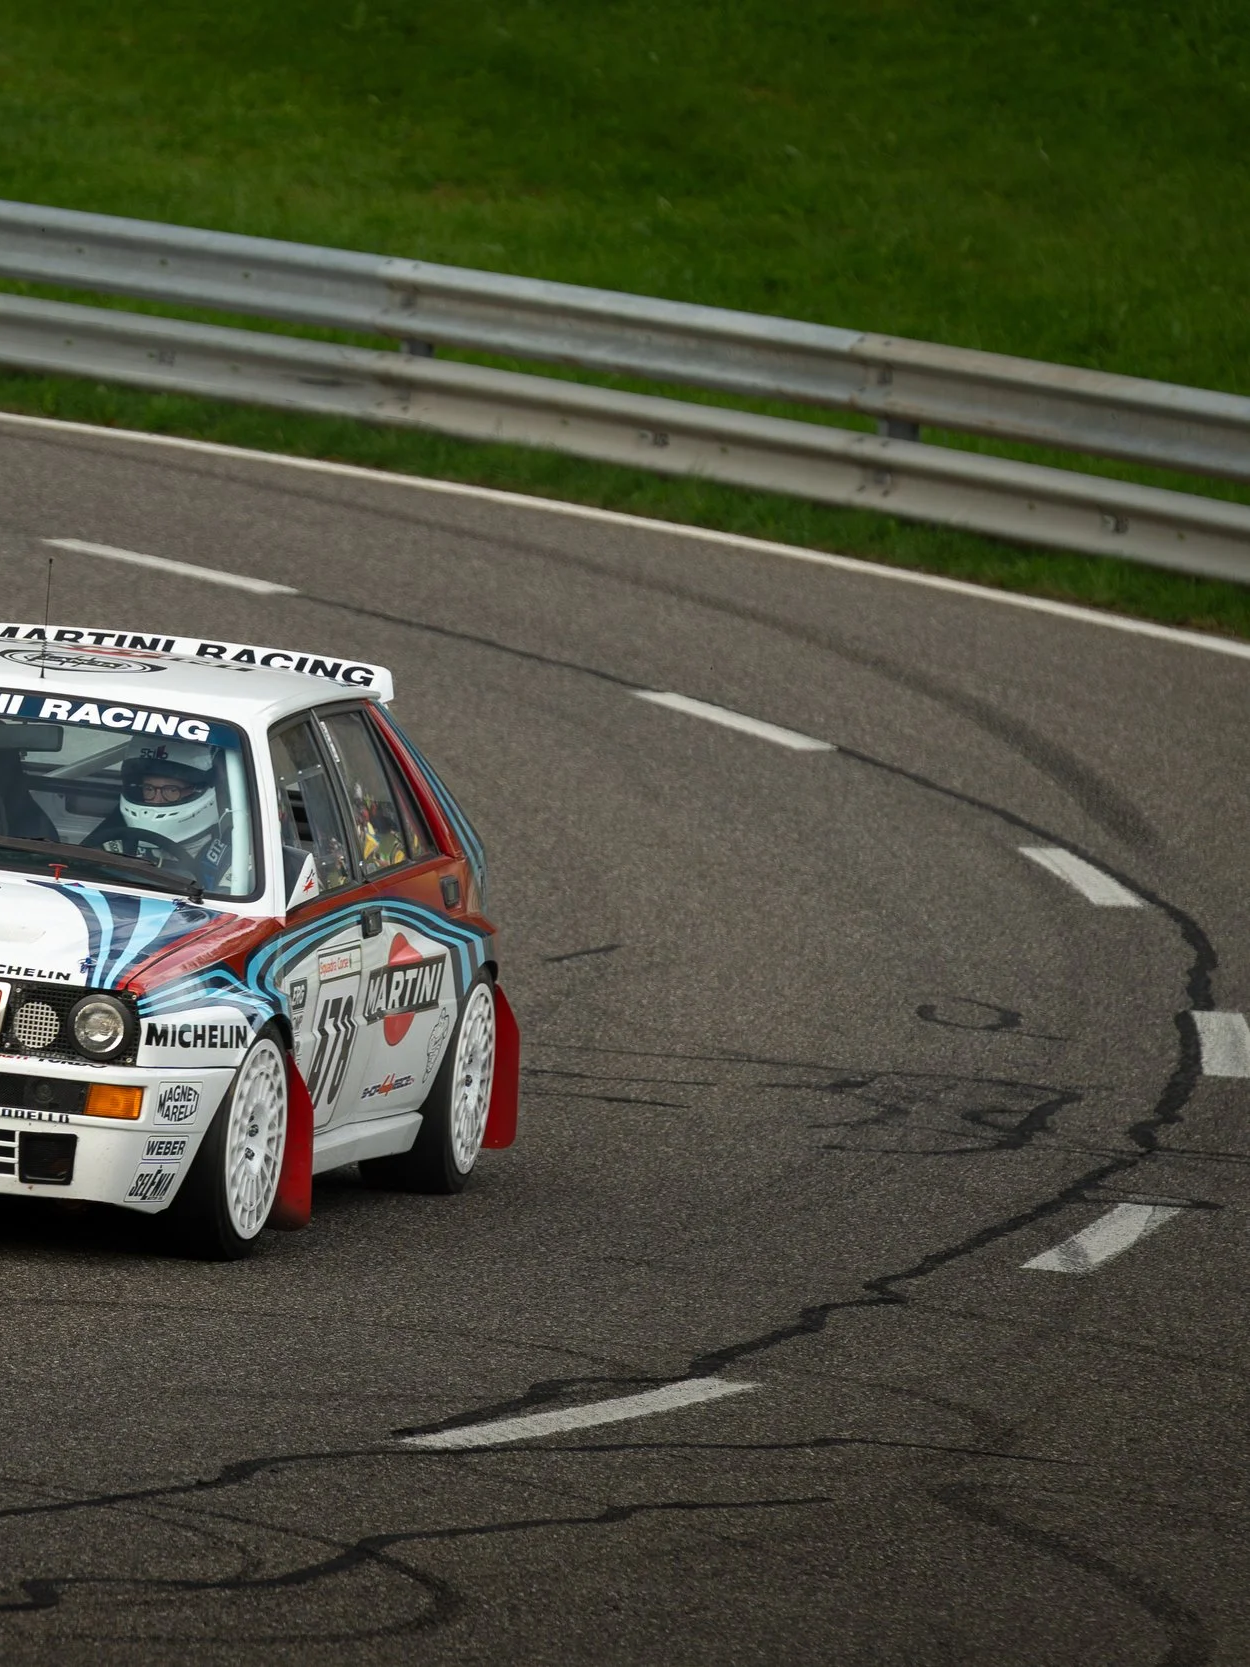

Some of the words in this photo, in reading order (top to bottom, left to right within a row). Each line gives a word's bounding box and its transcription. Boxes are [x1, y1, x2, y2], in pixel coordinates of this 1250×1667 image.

[196, 643, 375, 687] RACING
[39, 698, 211, 742] RACING
[365, 963, 443, 1017] MARTINI
[144, 1022, 248, 1049] MICHELIN
[159, 1085, 200, 1103] MAGNETI
[157, 1103, 198, 1122] MARELLI
[146, 1140, 186, 1156] WEBER
